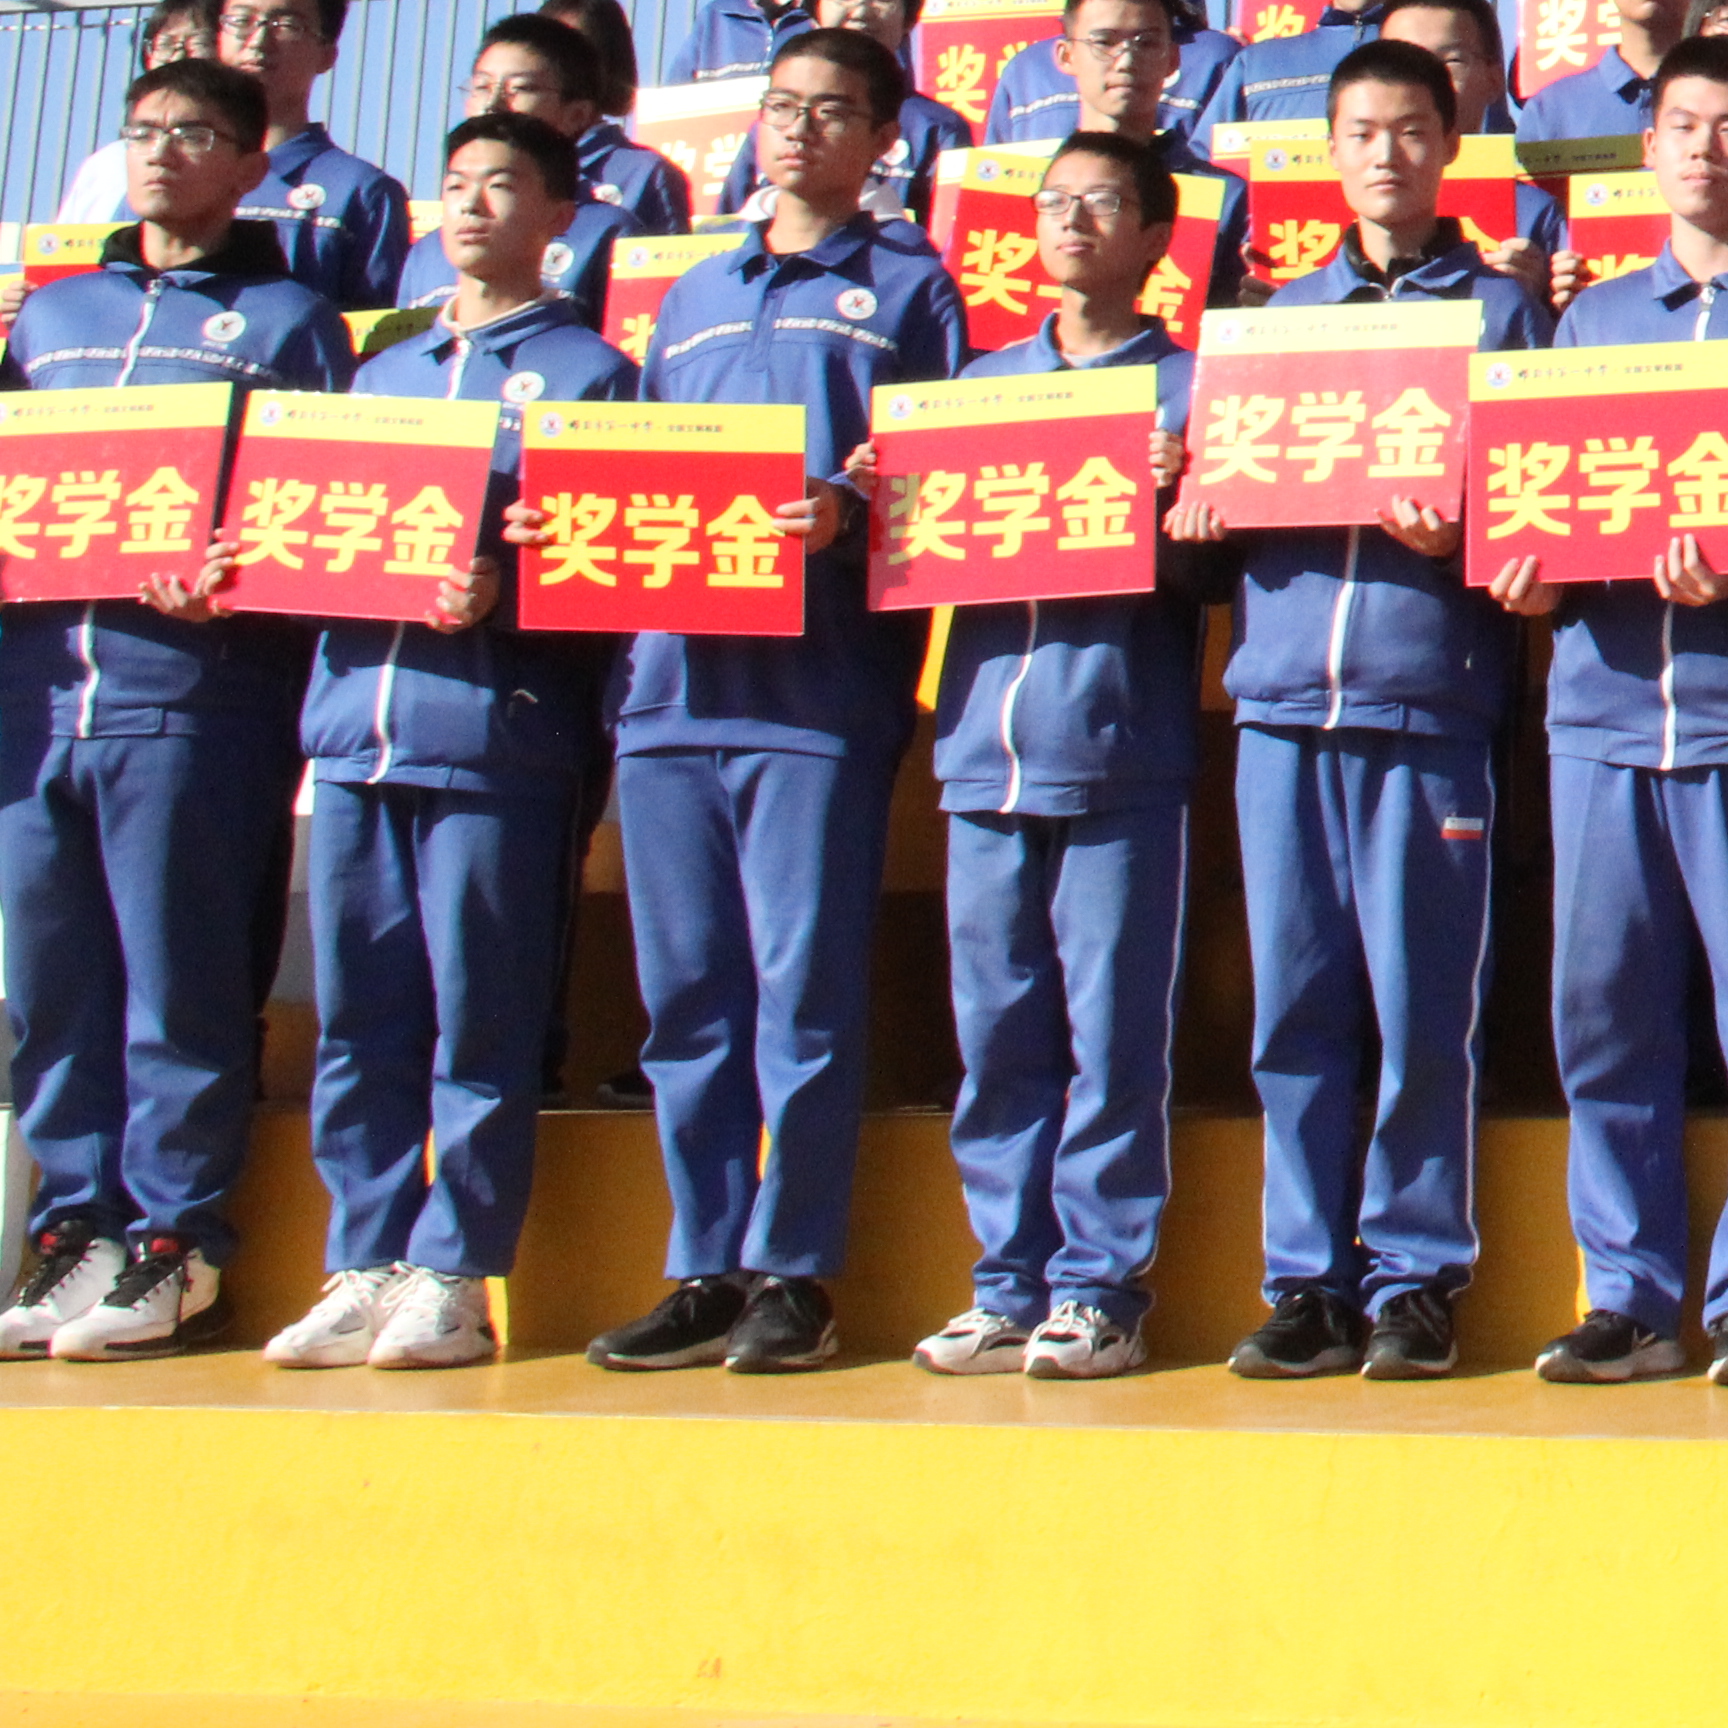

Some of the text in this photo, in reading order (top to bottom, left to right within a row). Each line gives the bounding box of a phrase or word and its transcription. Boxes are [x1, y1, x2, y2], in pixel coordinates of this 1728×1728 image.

[1201, 387, 1453, 486] 奖学金
[234, 478, 463, 576] 奖学金
[539, 492, 786, 589] 奖学金
[888, 456, 1137, 563] 奖学金
